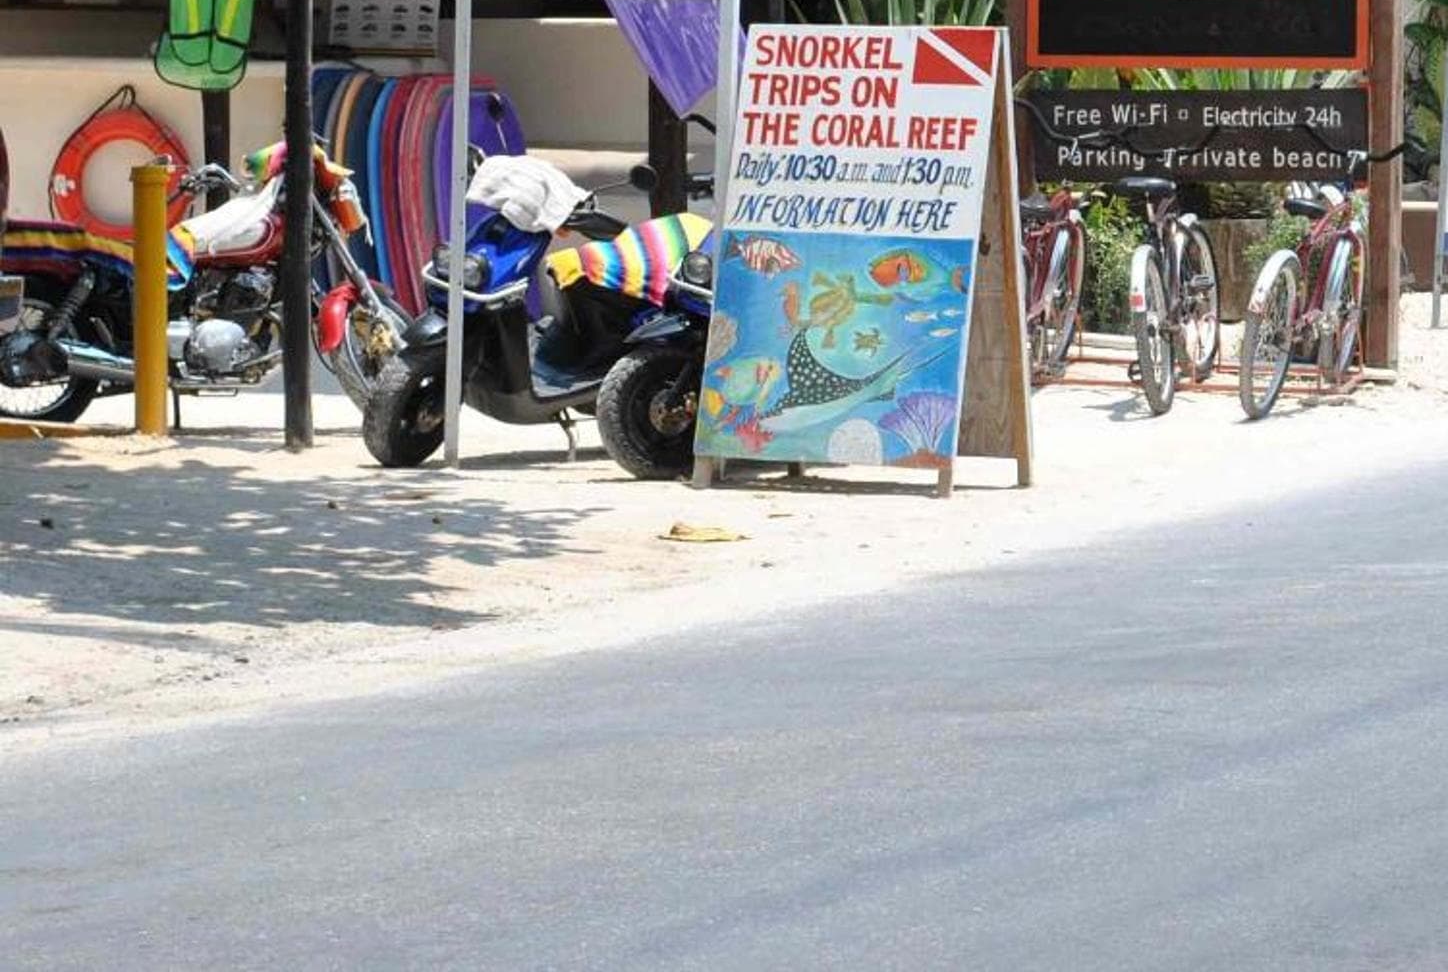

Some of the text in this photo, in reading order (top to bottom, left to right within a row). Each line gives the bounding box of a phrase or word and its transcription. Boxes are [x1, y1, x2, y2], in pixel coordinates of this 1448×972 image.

[755, 34, 904, 70] SNORKEL
[748, 73, 898, 108] TRIPS ON
[743, 113, 978, 151] THE CORAL REEF
[1053, 104, 1342, 129] Free Wi-Fi Electricity 24h
[1058, 145, 1145, 171] Parking
[731, 193, 959, 233] INFORMATION HERE
